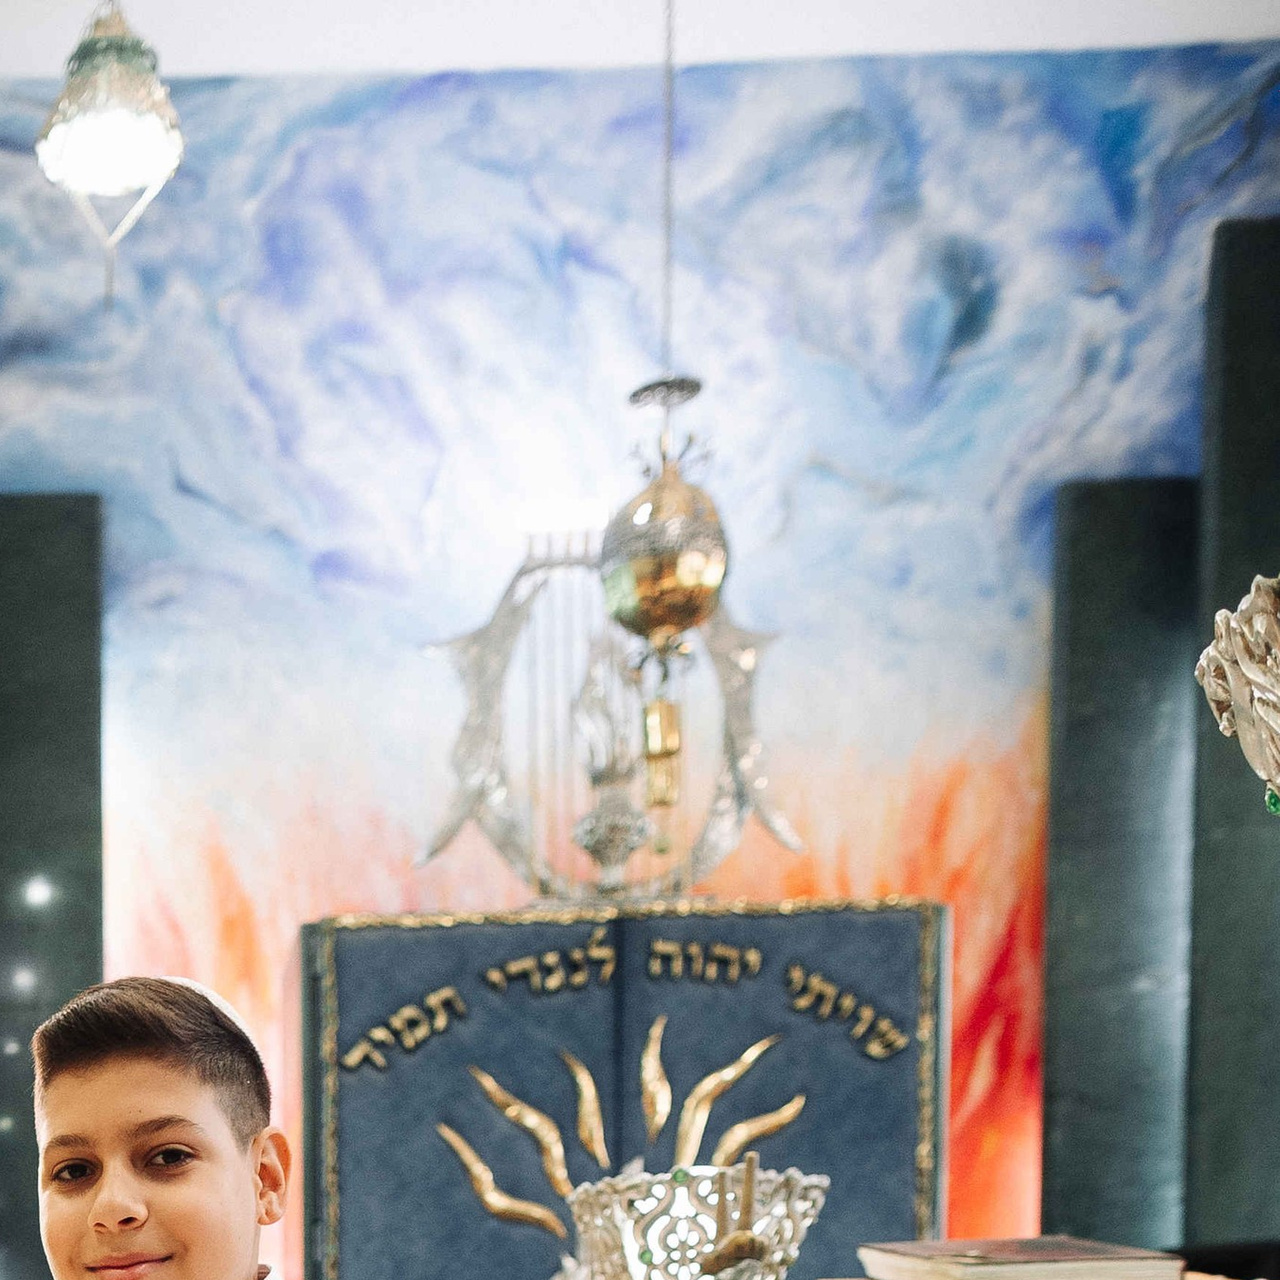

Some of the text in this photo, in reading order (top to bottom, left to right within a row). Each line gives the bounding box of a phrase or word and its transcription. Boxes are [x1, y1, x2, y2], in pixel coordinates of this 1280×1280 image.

[340, 927, 910, 1072] שויתי יהוה לנגדי תמיד
